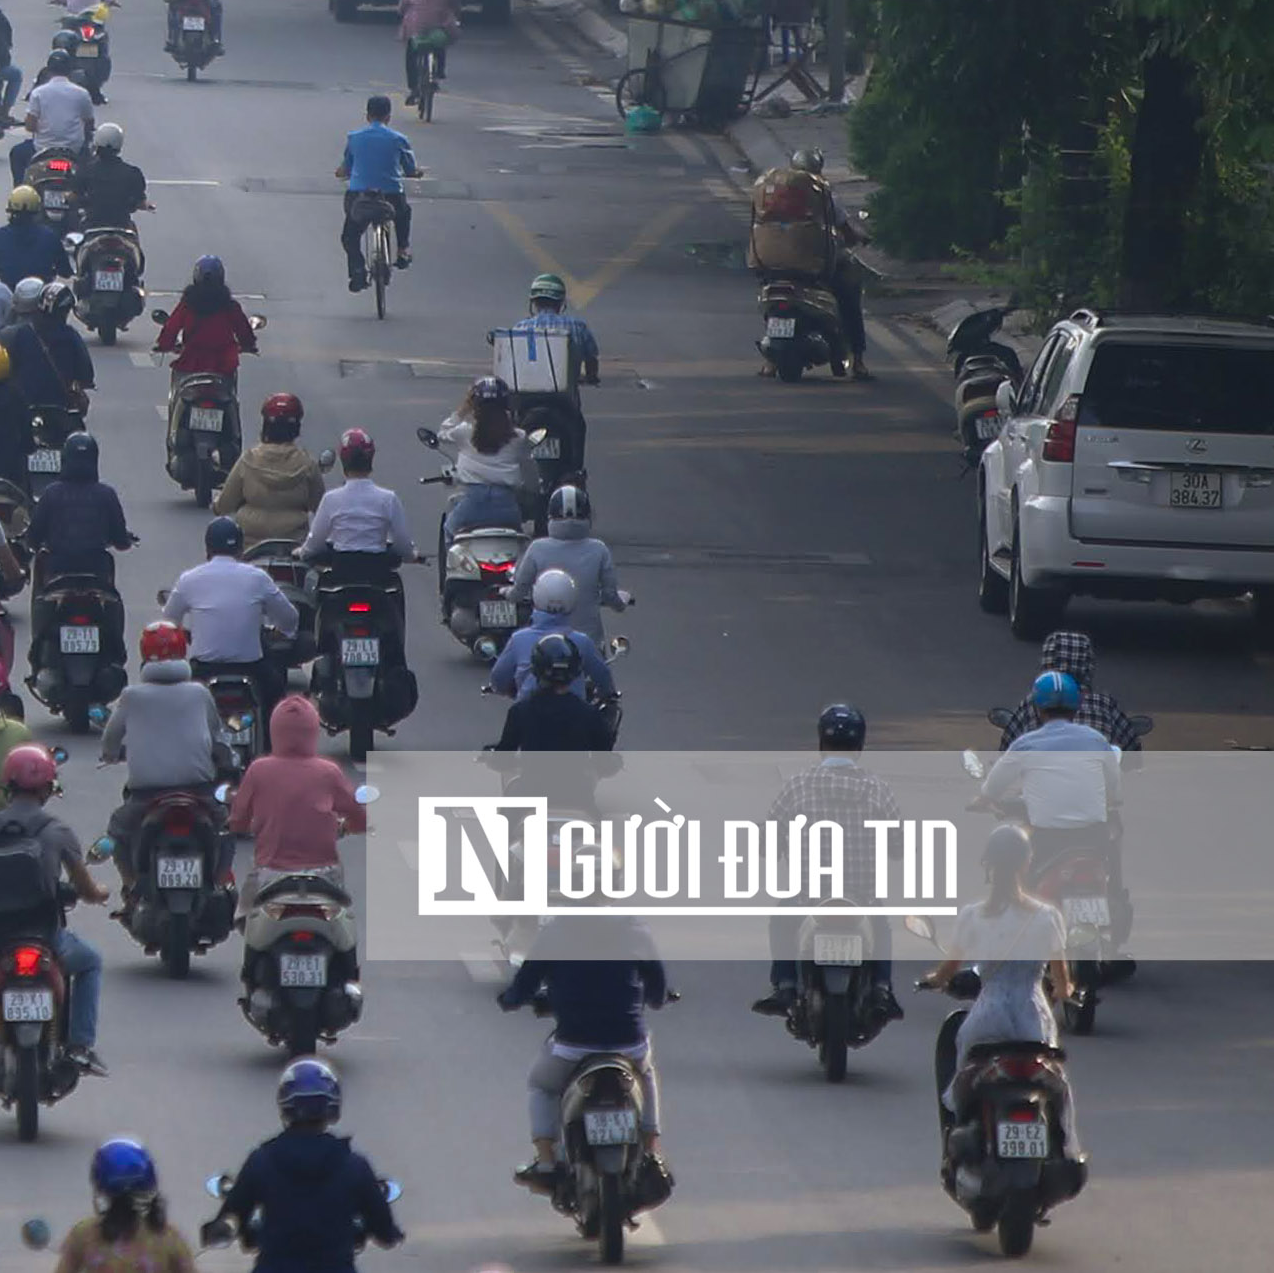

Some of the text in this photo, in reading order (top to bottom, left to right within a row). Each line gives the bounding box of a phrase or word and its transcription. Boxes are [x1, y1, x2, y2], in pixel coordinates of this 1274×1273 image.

[1183, 474, 1208, 489] 30A
[1172, 489, 1220, 506] 384.37
[1005, 1125, 1041, 1140] 29-E2
[1001, 1141, 1045, 1158] 398.01
